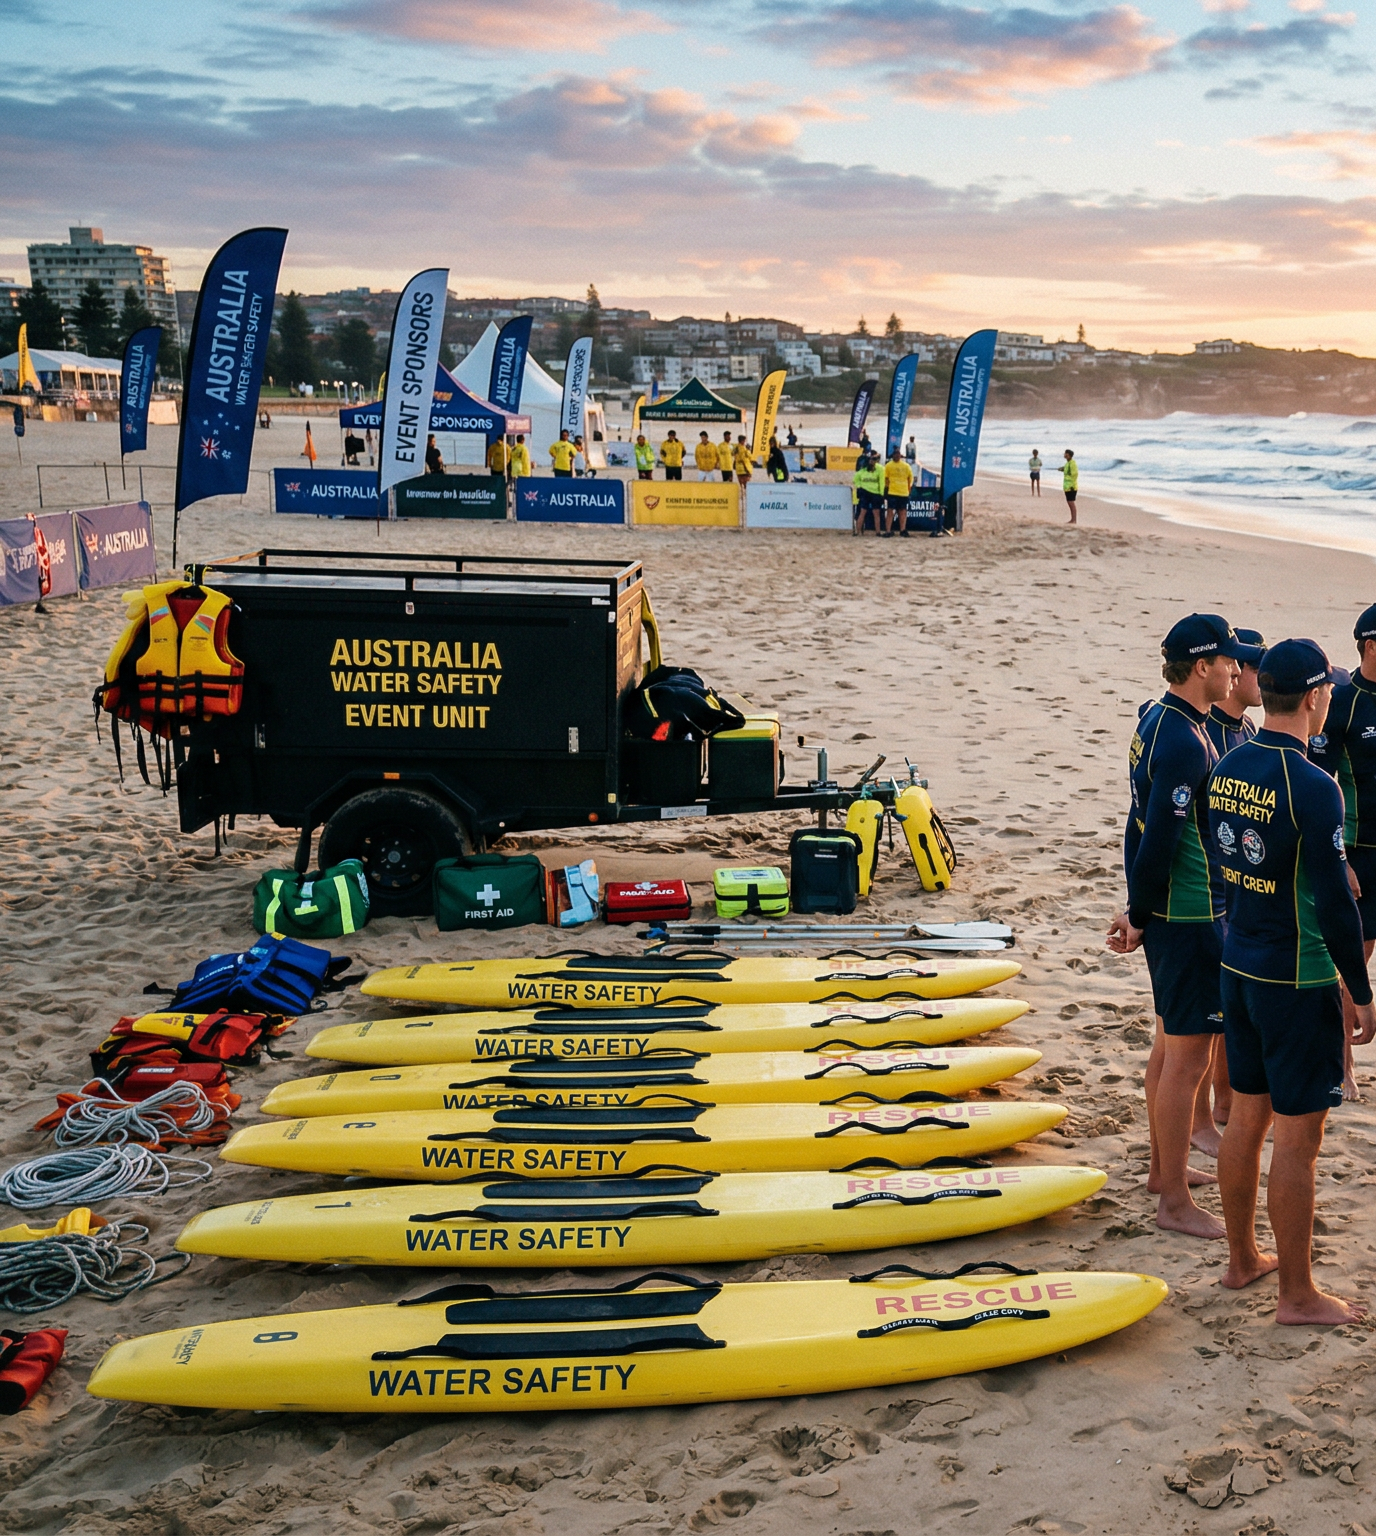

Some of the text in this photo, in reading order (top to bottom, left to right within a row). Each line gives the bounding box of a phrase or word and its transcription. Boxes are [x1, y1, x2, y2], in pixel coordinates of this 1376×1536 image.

[205, 270, 249, 404] AUSTRALIA
[395, 291, 434, 463] EVENT SPONSORS
[954, 355, 978, 436] AUSTRALIA
[311, 484, 379, 500] AUSTRALIA
[549, 493, 616, 508] AUSTRALIA
[105, 527, 149, 557] AUSTRALIA
[329, 638, 502, 669] AUSTRALIA
[330, 671, 502, 695] WATER SAFETY
[345, 703, 491, 728] EVENT UNIT
[1210, 776, 1276, 809] AUSTRALIA
[1238, 801, 1274, 824] SAFETY
[1243, 874, 1276, 894] CREW
[464, 908, 515, 919] FIRST AID
[508, 983, 663, 1003] WATER SAFETY
[475, 1038, 650, 1056] WATER SAFETY
[828, 1105, 992, 1125] RESCUE
[421, 1146, 627, 1171] WATER SAFETY
[847, 1170, 1022, 1194] RESCUE
[405, 1225, 632, 1252] WATER SAFETY
[875, 1281, 1077, 1315] RESCUE
[368, 1364, 637, 1396] WATER SAFETY
